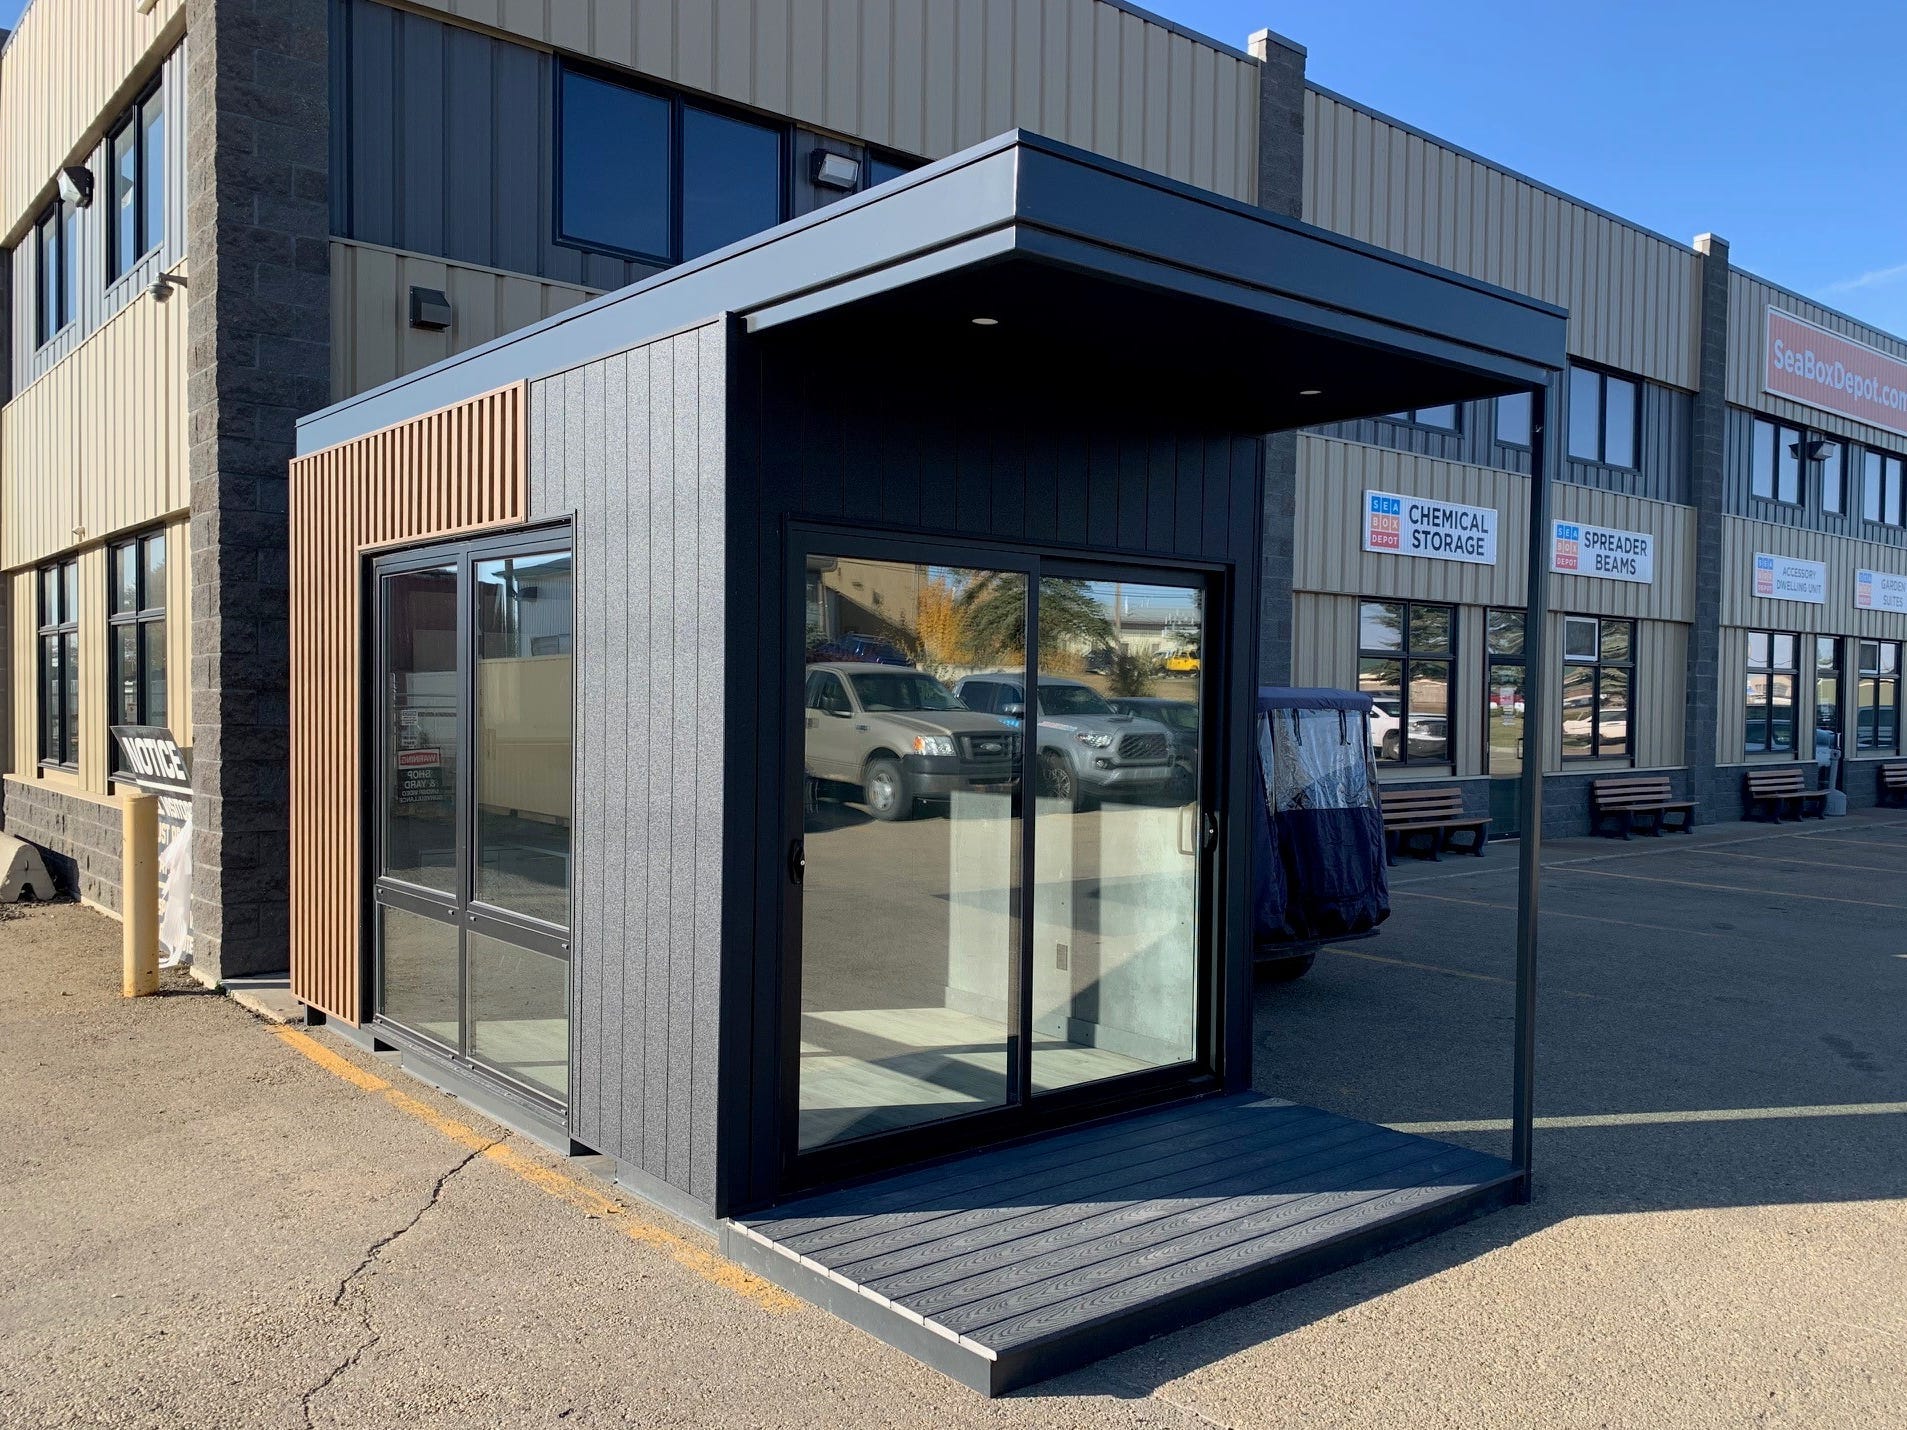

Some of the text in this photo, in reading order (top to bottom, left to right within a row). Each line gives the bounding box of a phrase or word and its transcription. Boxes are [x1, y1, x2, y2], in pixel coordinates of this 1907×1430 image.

[1373, 500, 1399, 512] SEA
[1372, 517, 1398, 529] BOX
[1409, 504, 1488, 533] CHEMICAL
[1558, 526, 1578, 538] SEA
[1372, 534, 1398, 545] DEPOT
[1412, 529, 1485, 556] STORAGE
[1584, 531, 1647, 556] SPREADER
[1557, 557, 1577, 567] DEPOT
[1595, 553, 1636, 575] BEAMS
[1783, 567, 1817, 579] ACCESSORY
[1776, 579, 1822, 595] DWELLING UNIT
[1881, 578, 1906, 592] GARDEN
[1883, 595, 1904, 608] SUITES
[122, 737, 186, 780] NOTICE
